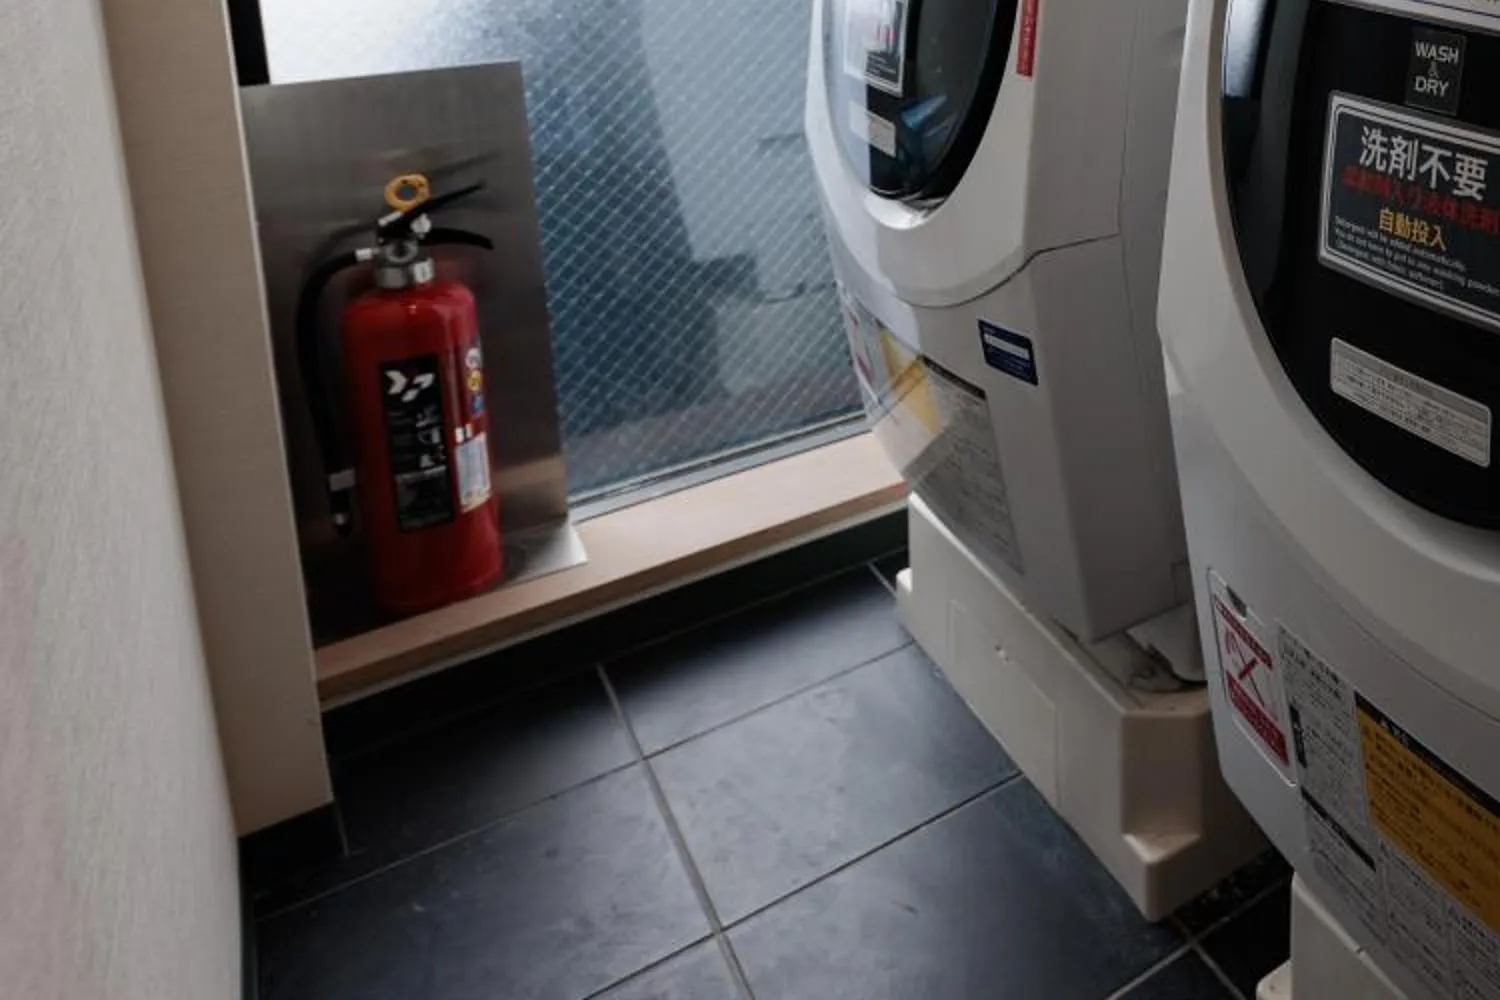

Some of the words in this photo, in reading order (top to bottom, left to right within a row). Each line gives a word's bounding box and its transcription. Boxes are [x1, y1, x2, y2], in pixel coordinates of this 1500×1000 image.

[1415, 41, 1459, 65] WASH
[1414, 76, 1449, 98] DRY
[1359, 125, 1489, 201] 洗剤不要
[1378, 207, 1448, 252] 自動投入
